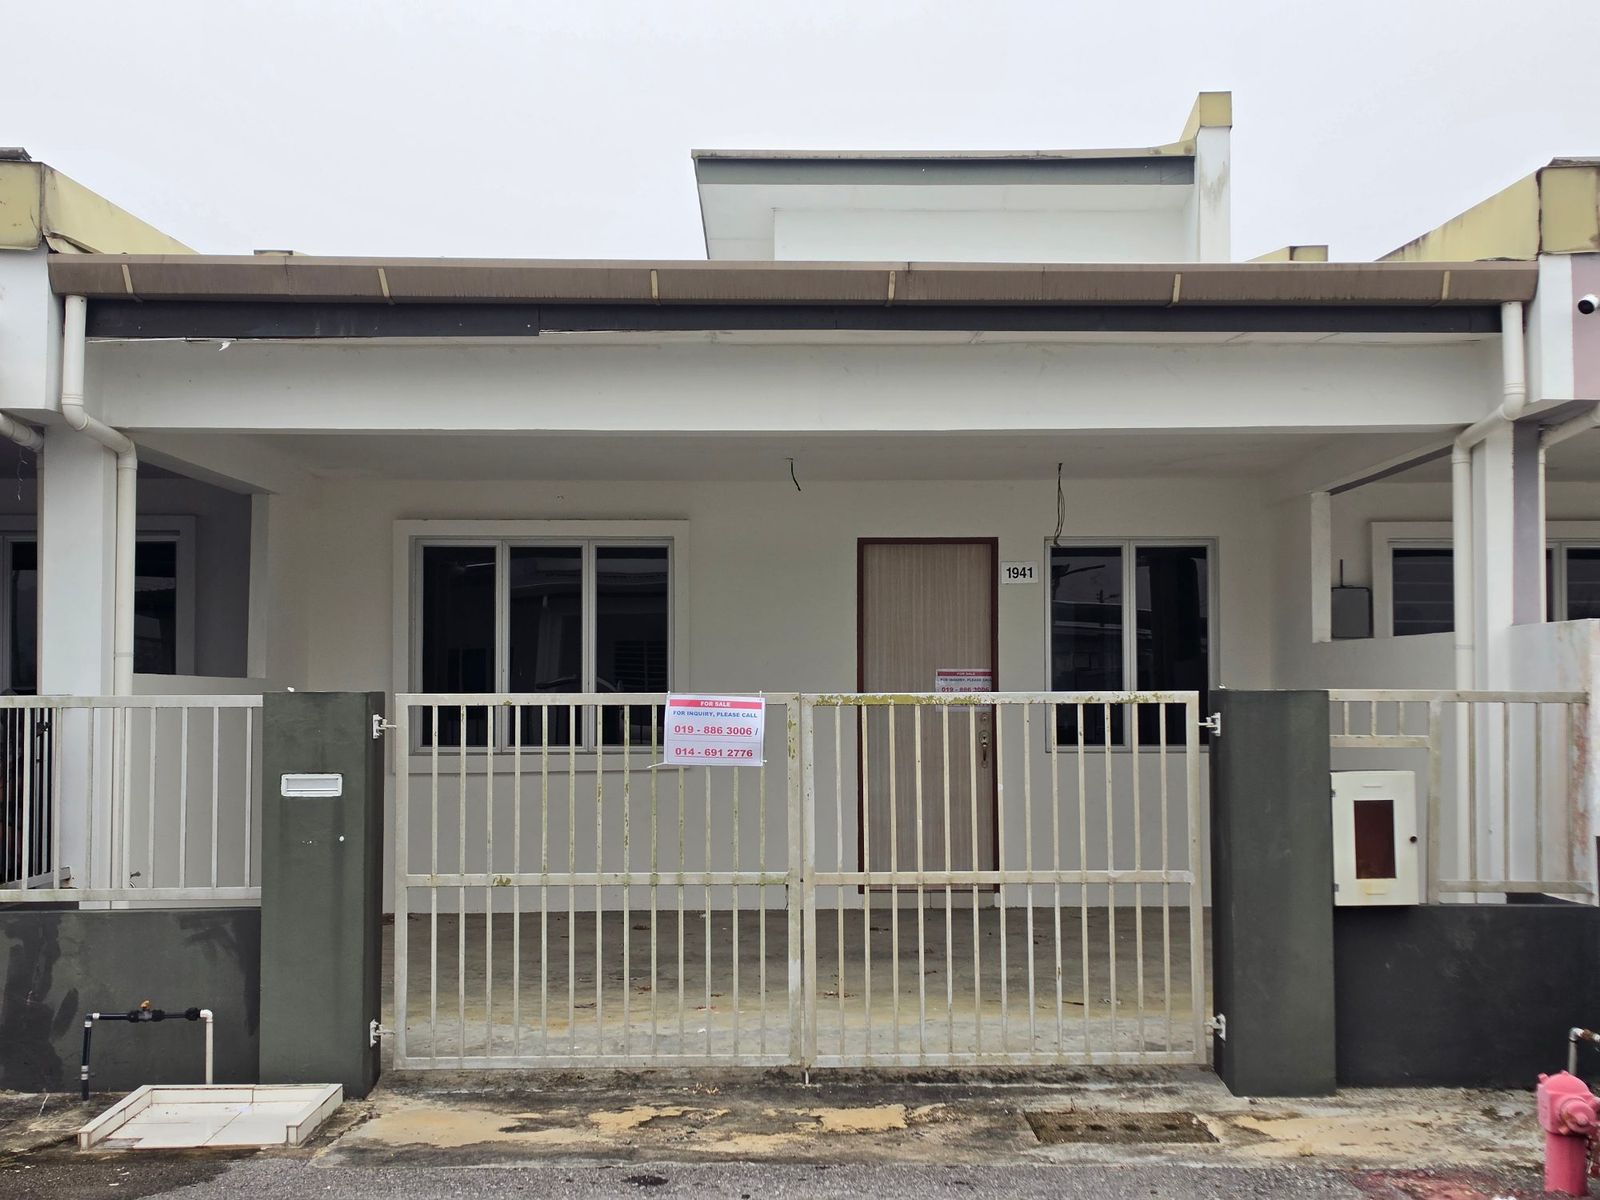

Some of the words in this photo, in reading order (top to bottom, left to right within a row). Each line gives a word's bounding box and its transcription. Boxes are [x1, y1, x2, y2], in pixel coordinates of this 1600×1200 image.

[1006, 567, 1033, 579] 1941
[674, 725, 694, 734] 019
[703, 726, 723, 734] 886
[726, 726, 752, 735] 3006
[675, 747, 695, 756] 014
[704, 748, 723, 756] 691
[727, 749, 753, 757] 2776
